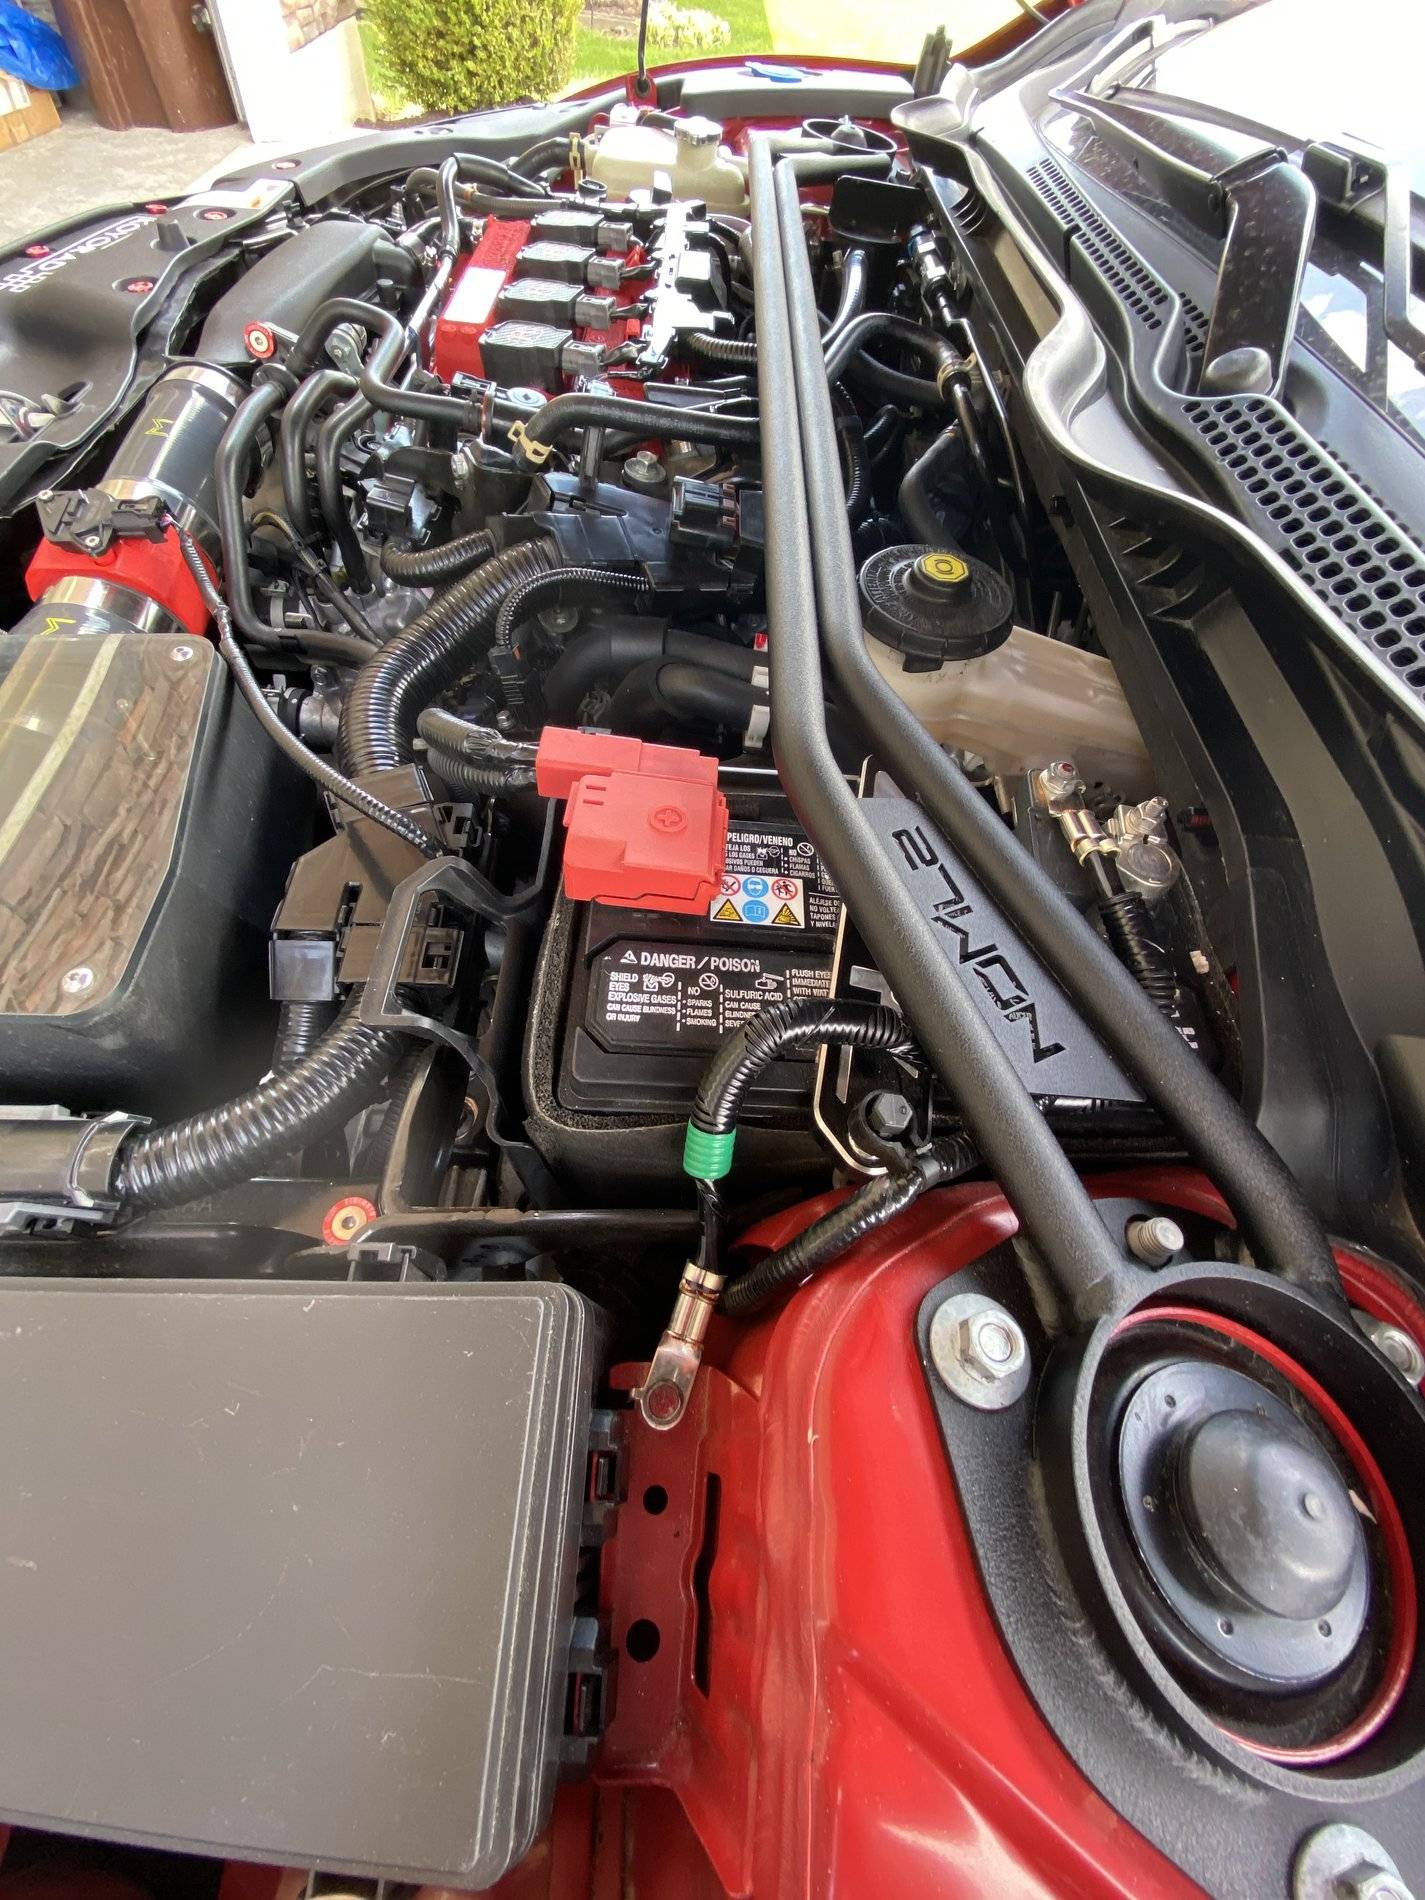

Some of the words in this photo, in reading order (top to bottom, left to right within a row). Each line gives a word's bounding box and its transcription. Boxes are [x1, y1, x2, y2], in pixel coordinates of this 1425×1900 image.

[727, 832, 793, 847] PELIGRO/VENENO
[756, 867, 779, 875] CEGUERA
[640, 951, 696, 969] DANGER
[710, 957, 760, 972] POISON
[610, 972, 638, 982] SHIELD
[791, 969, 814, 978] FLUSH
[609, 982, 630, 991] EYES
[792, 978, 830, 988] IMMEDIAT
[688, 987, 700, 995] NO
[725, 989, 763, 1000] SULFURIC
[764, 992, 783, 1001] ACID
[793, 987, 811, 995] WITH
[812, 988, 829, 997] WAT
[608, 991, 650, 1003] EXPLOSIVE
[651, 995, 676, 1004] GASES
[687, 999, 712, 1007] SPARKS
[725, 1001, 738, 1009] CAN
[740, 1002, 761, 1010] CAUSE
[607, 1003, 620, 1011] CAN
[621, 1004, 642, 1013] CAUSE
[643, 1006, 676, 1015] BLINDNESS
[686, 1008, 712, 1016] FLAMES
[618, 1014, 640, 1022] INJURY
[686, 1018, 717, 1026] SMOKING
